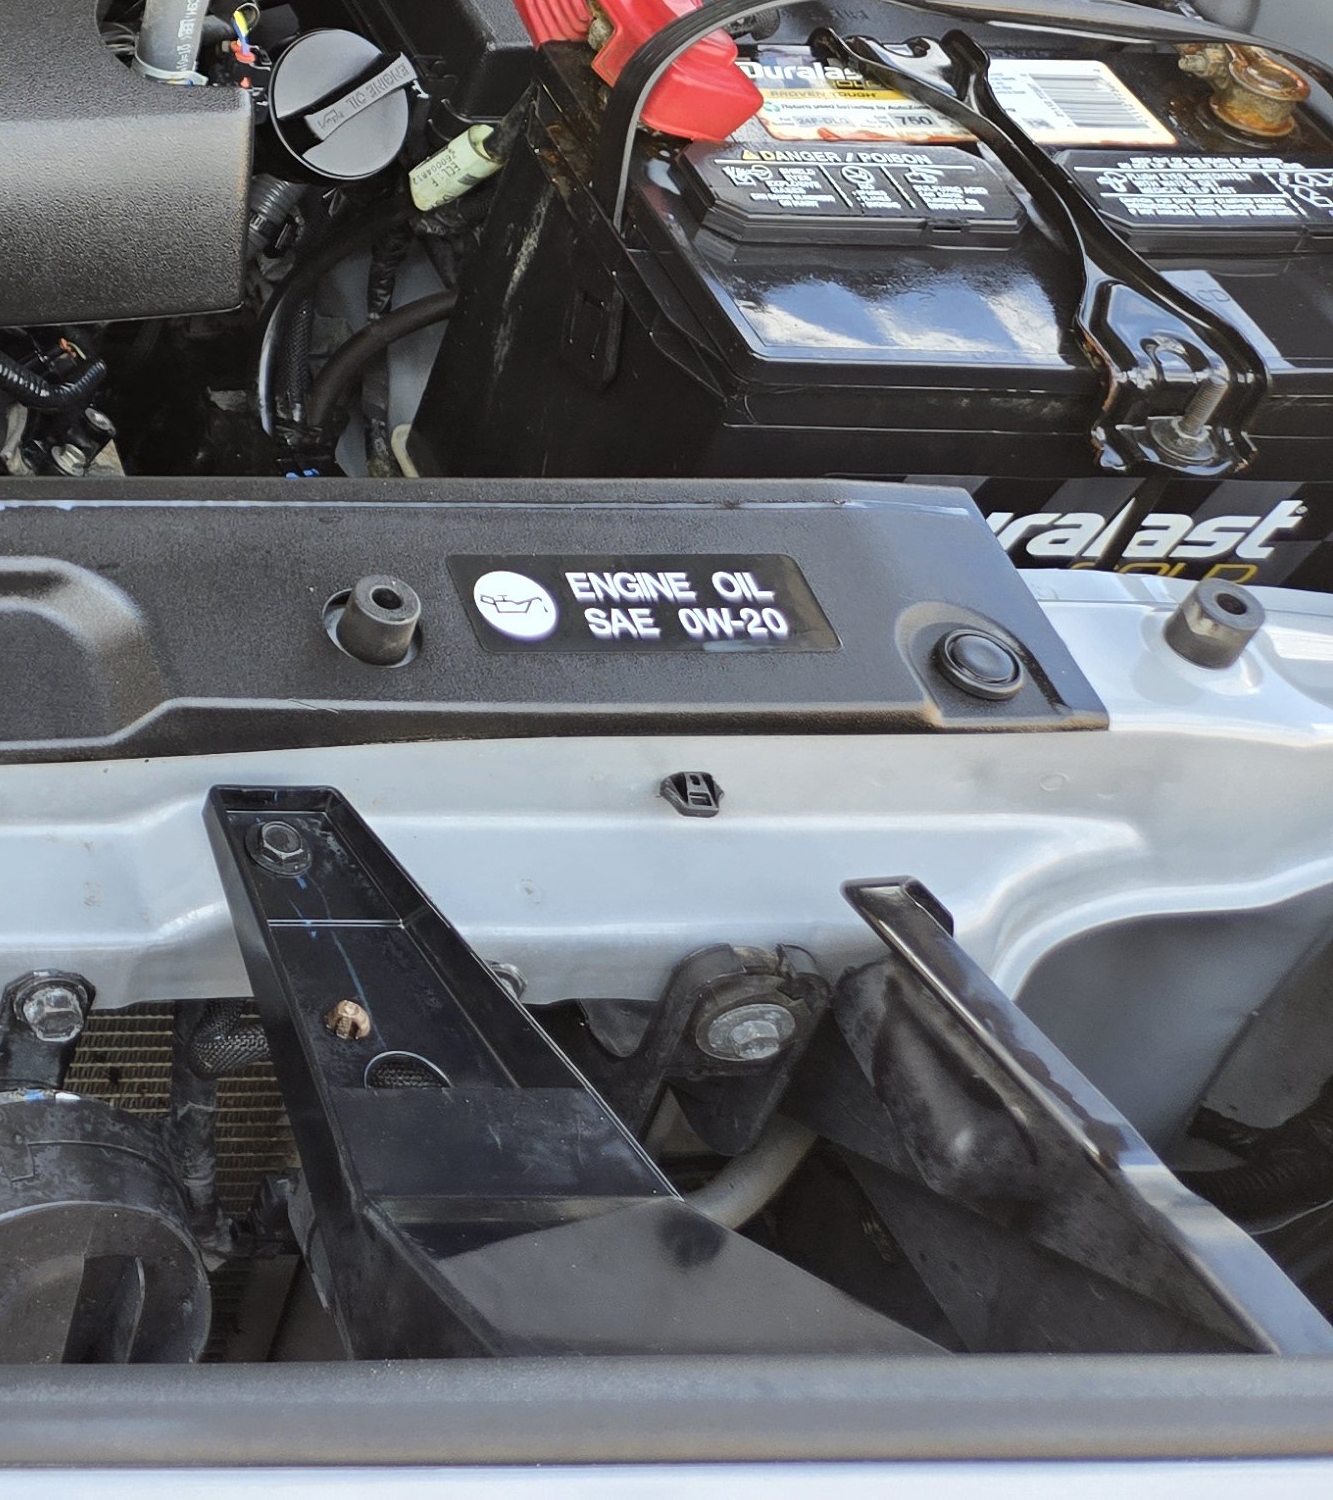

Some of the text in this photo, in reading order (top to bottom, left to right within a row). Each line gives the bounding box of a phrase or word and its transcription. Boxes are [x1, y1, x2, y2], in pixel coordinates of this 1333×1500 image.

[345, 62, 410, 110] ENGINE OIL
[895, 114, 933, 126] 750
[758, 150, 840, 163] DANGER
[861, 152, 933, 165] POISON
[565, 571, 776, 603] ENGINE OIL
[583, 607, 791, 640] SAE 0W-20
